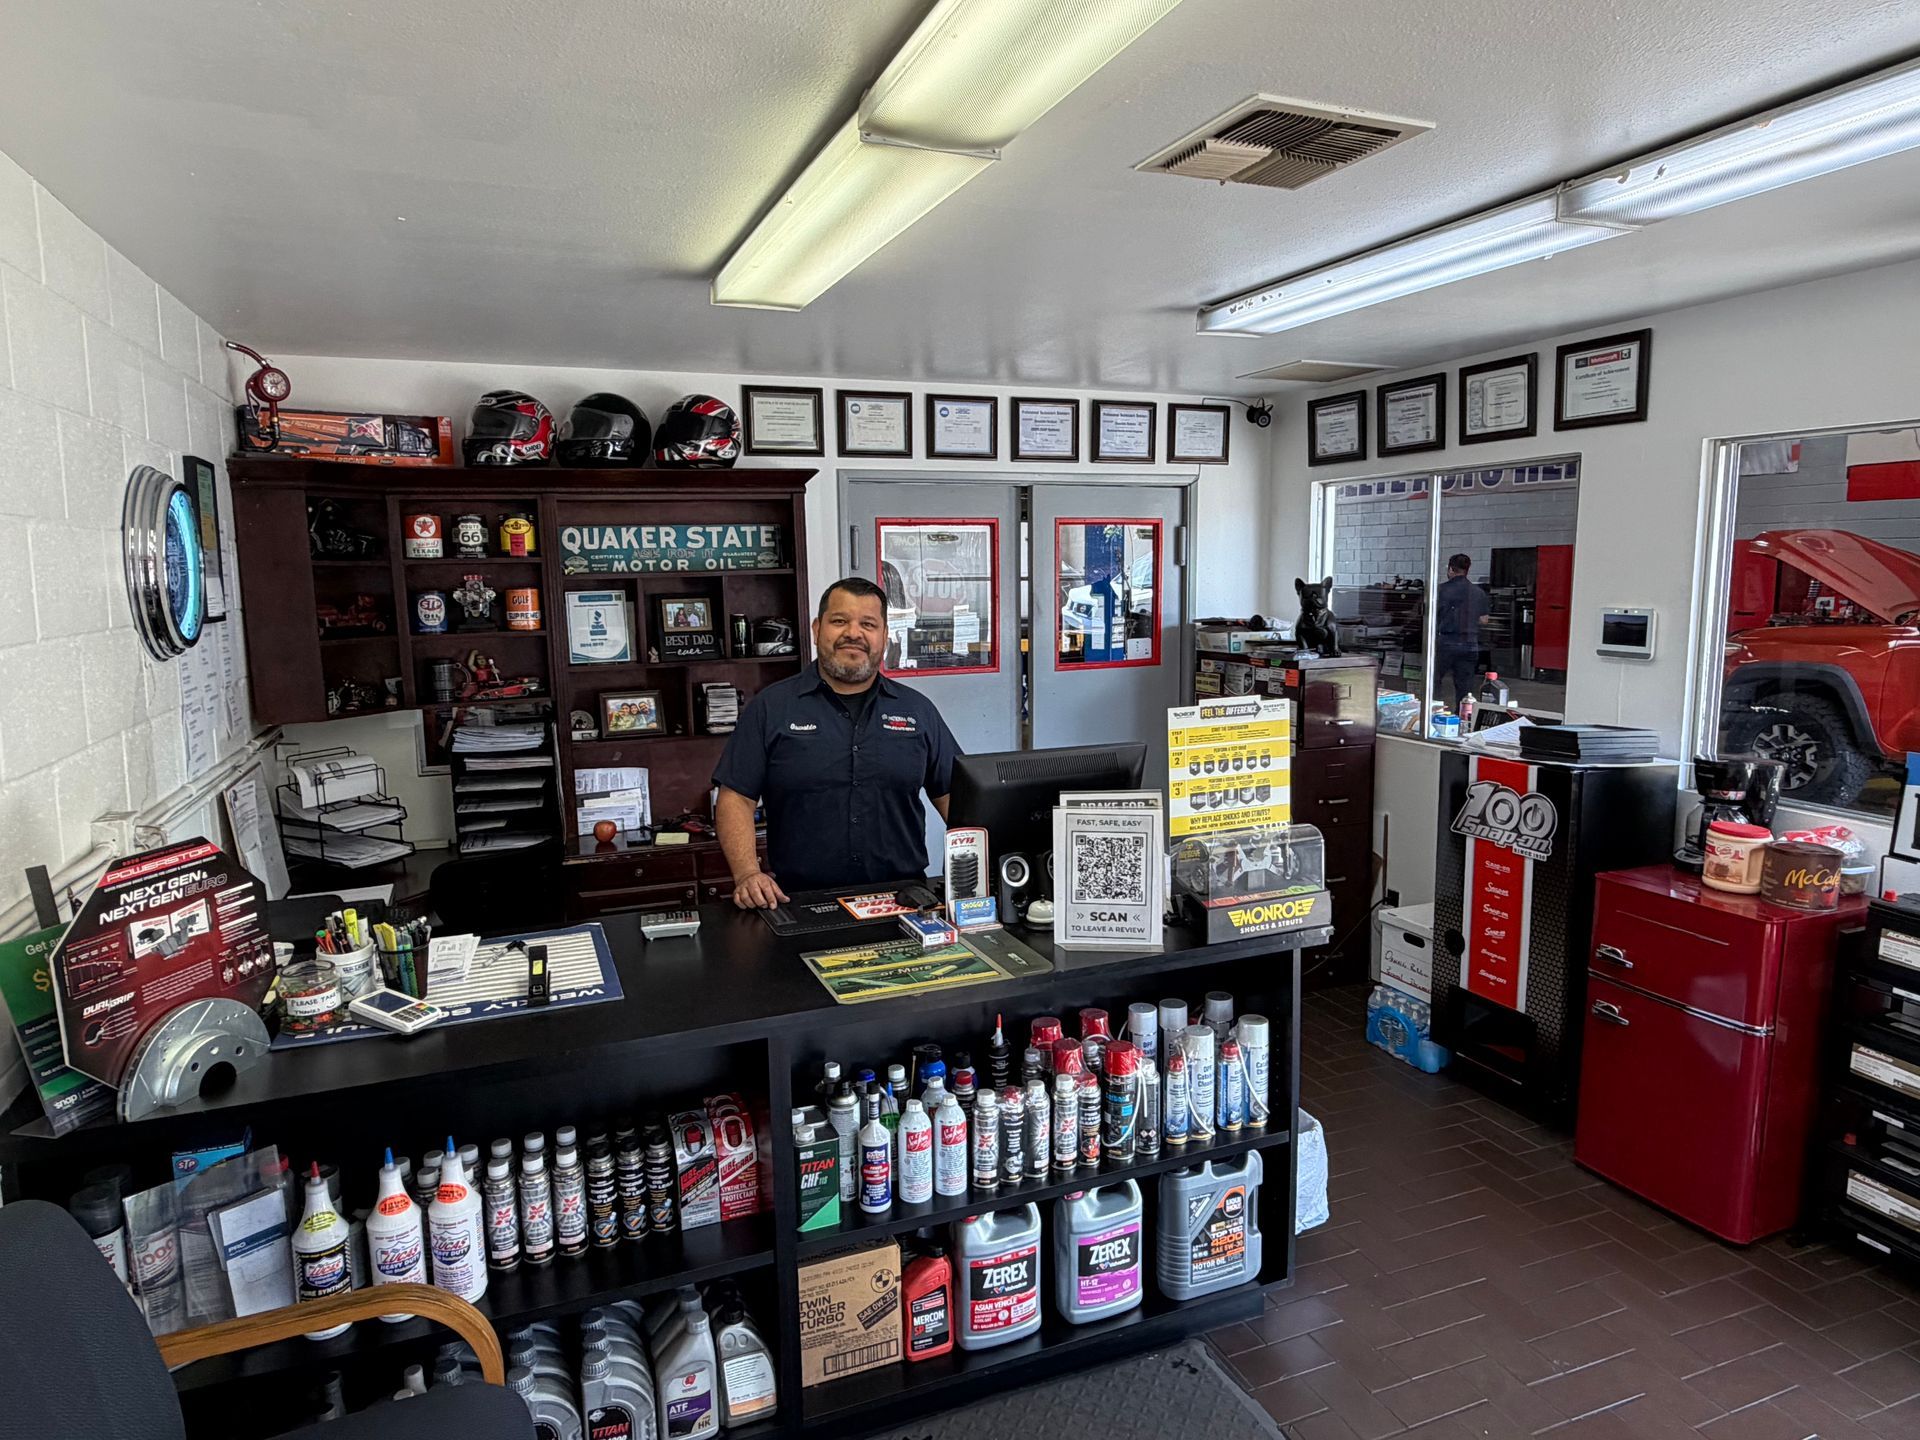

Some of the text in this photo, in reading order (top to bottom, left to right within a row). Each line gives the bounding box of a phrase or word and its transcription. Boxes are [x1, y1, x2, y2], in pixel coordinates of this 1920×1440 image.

[1575, 373, 1597, 381] Certificate
[1603, 367, 1630, 376] Achievement
[524, 443, 543, 455] SHOEI
[461, 532, 482, 543] 66
[561, 525, 776, 555] QUAKER STATE
[667, 549, 696, 559] FOR
[702, 548, 715, 559] IT
[612, 558, 737, 573] MOTOR OIL
[910, 564, 966, 602] STOP
[420, 601, 442, 609] STP
[512, 596, 530, 605] GULF
[508, 612, 539, 620] SUPREME
[665, 634, 715, 647] BEST DAD
[677, 648, 704, 657] ever
[1201, 708, 1214, 718] FEEL
[1215, 707, 1226, 716] THE
[1226, 704, 1258, 716] DIFFERENCE
[1174, 758, 1181, 766] 2
[1174, 788, 1181, 796] 3
[1190, 808, 1271, 825] WHY REPLACE SHOCKS AND STRUTS?
[1460, 781, 1557, 838] 100
[1077, 818, 1142, 827] FAST, SAFE, EASY
[1459, 815, 1551, 852] Snap-on
[951, 836, 975, 847] KYB
[1513, 848, 1533, 857] SINCE
[106, 846, 212, 883] POWERSTOP
[119, 881, 168, 906] NEXT
[167, 871, 202, 890] GEN
[99, 900, 150, 926] NEXT
[149, 888, 184, 909] GEN
[184, 873, 229, 898] EURO
[1090, 912, 1128, 922] SCAN
[1239, 901, 1304, 926] MONROE
[1079, 925, 1107, 933] LEAVE
[1114, 926, 1146, 934] REVIEW
[1240, 924, 1270, 934] SHOCKS
[1278, 918, 1304, 928] STRUTS
[25, 943, 47, 956] Get
[825, 946, 857, 956] Vehicle
[859, 942, 891, 951] control
[880, 964, 933, 978] or More
[290, 998, 319, 1008] PLEASE
[483, 987, 605, 1012] WELY
[54, 1094, 78, 1110] snap
[178, 1160, 196, 1170] STP
[800, 1158, 836, 1174] TITAN
[801, 1171, 819, 1189] CHF
[721, 1183, 747, 1193] SYNTHETIC
[721, 1189, 757, 1203] PROTECTANT
[1211, 1225, 1243, 1239] TOP TEC
[1211, 1231, 1244, 1247] 4200
[228, 1241, 247, 1253] PRO
[435, 1237, 467, 1250] LUCAS
[1211, 1245, 1223, 1255] SAE
[383, 1244, 419, 1264] LUCAS
[452, 1247, 468, 1257] DUTY
[1089, 1236, 1131, 1266] ZEREX
[380, 1261, 405, 1271] HEAVY
[1192, 1257, 1227, 1272] MOTOR OIL
[983, 1260, 1028, 1289] ZEREX
[800, 1295, 832, 1311] TWIN
[859, 1291, 895, 1321] SAE 0W-20
[974, 1296, 1018, 1312] ASIAN VEHICLE
[800, 1301, 846, 1320] POWER
[800, 1312, 845, 1331] TURBO
[914, 1310, 945, 1327] MERCON
[669, 1402, 690, 1415] ATF
[591, 1421, 630, 1439] TITAN
[697, 1418, 712, 1430] HK
